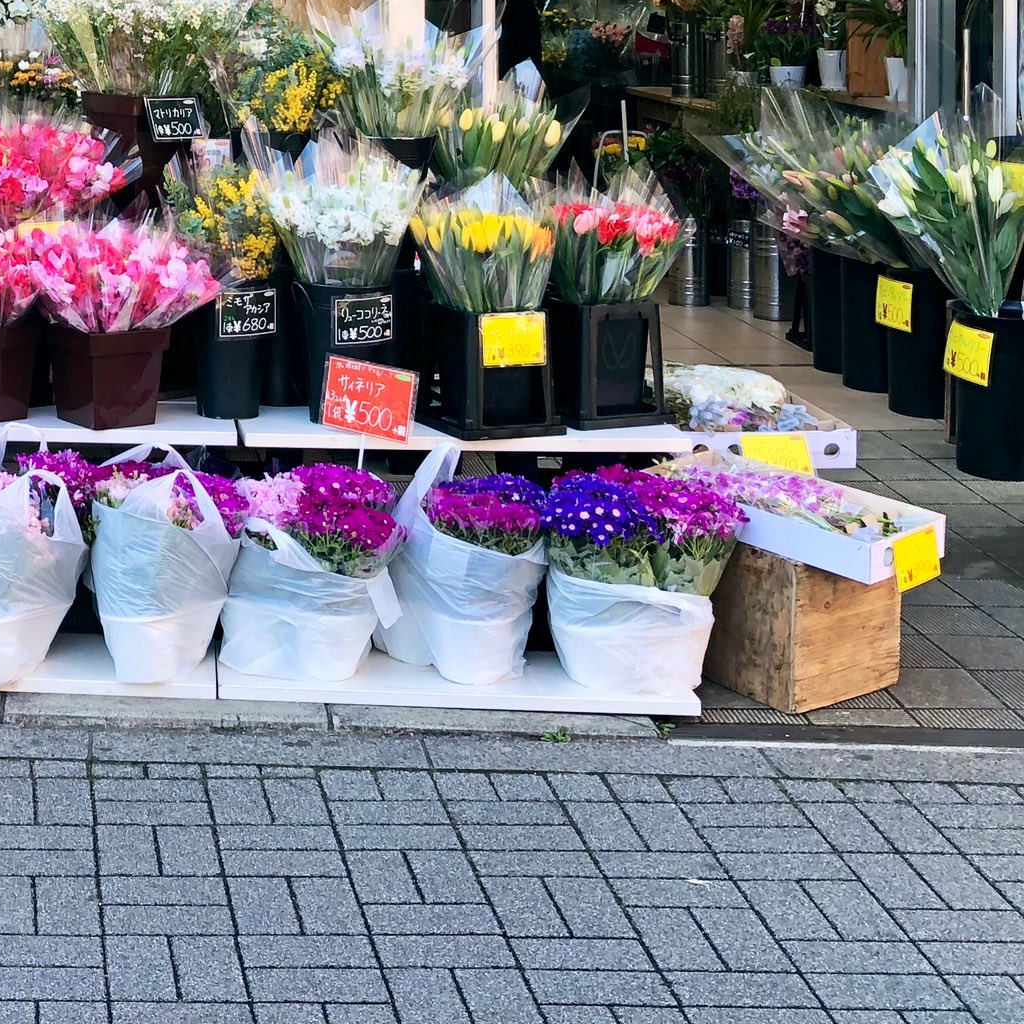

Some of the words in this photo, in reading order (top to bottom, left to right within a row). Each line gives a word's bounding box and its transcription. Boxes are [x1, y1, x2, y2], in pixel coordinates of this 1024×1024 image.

[153, 107, 193, 119] マトリカリア
